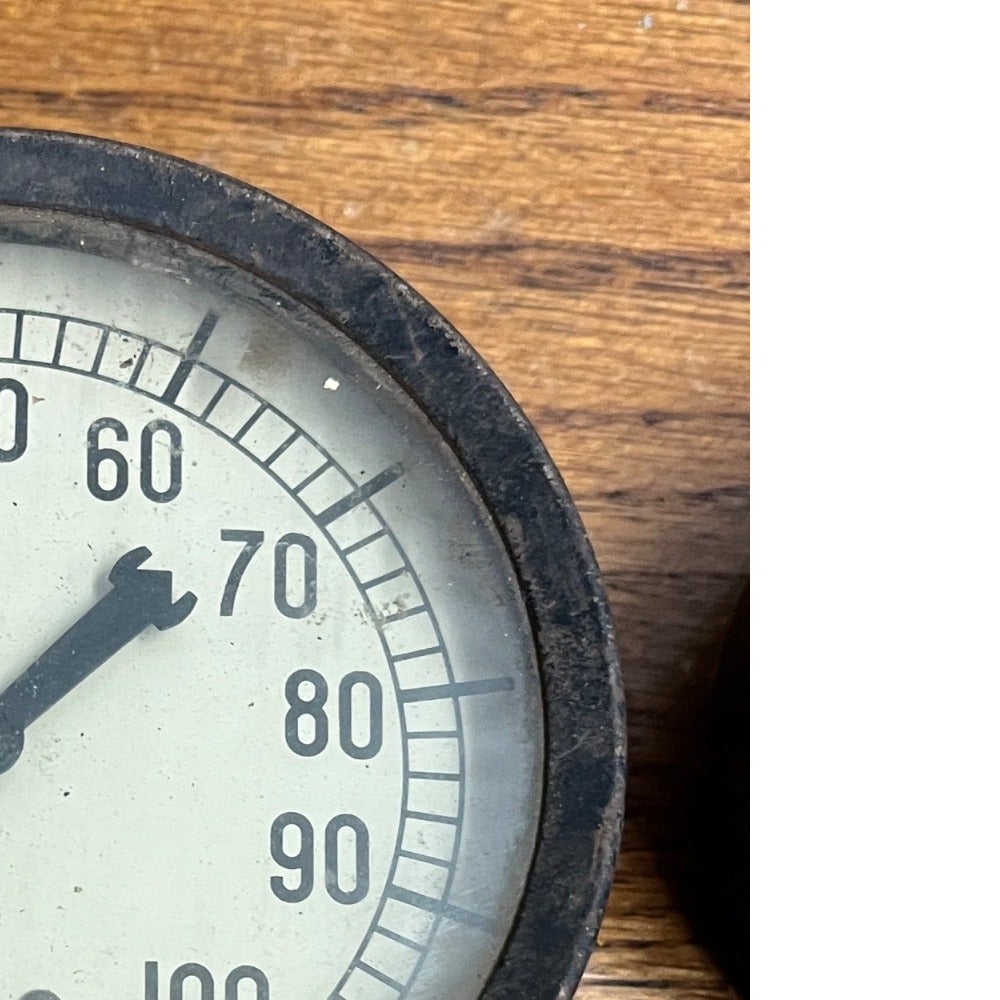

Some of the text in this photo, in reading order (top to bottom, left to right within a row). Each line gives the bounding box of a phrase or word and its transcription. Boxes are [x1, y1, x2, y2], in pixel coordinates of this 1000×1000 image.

[87, 417, 183, 503] 60
[220, 529, 318, 619] 70
[285, 668, 383, 760] 80
[270, 811, 370, 905] 90
